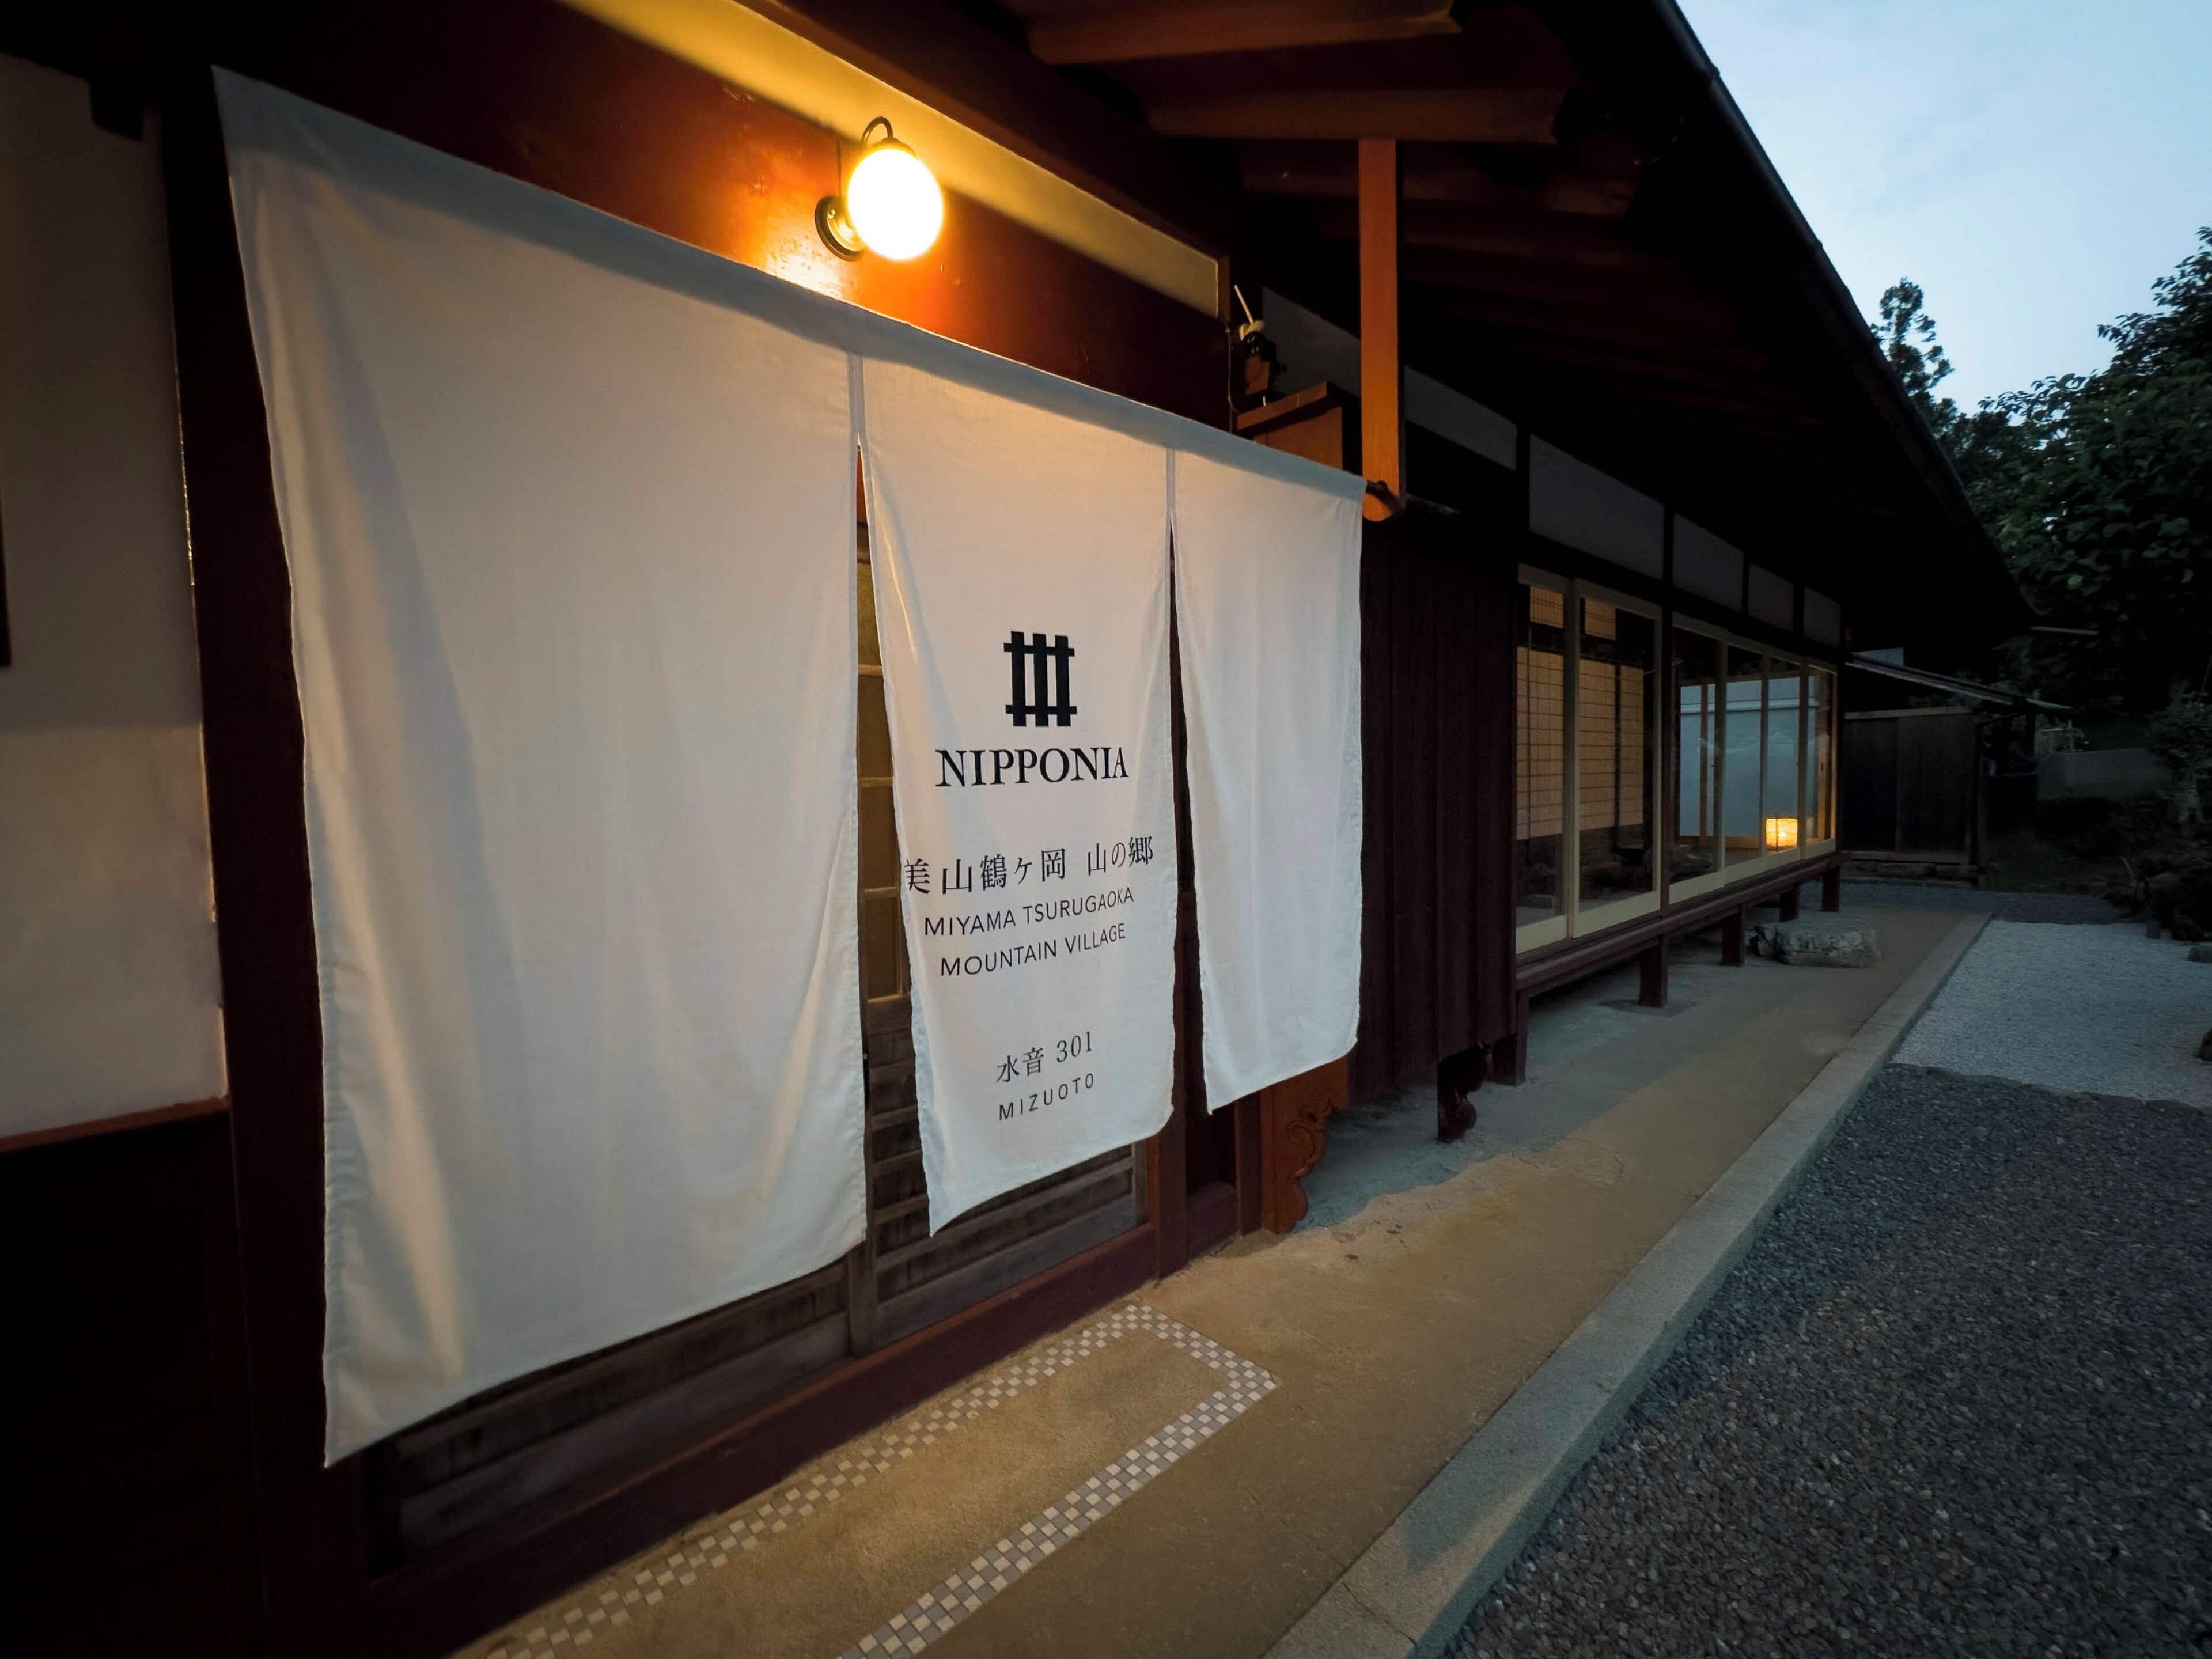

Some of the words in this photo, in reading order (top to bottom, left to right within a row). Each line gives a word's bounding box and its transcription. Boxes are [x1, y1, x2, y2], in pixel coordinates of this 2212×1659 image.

[935, 747, 1129, 787] NIPPONIA
[1087, 835, 1154, 876] 山の郷
[925, 909, 1016, 936] MIYAMA
[1022, 887, 1134, 924] TSURUGAOKA
[941, 939, 1057, 976] MOUNTAIN
[1064, 922, 1126, 955] VILLAGE
[996, 1047, 1044, 1083] 水音
[1056, 1031, 1092, 1063] 301
[999, 1073, 1094, 1120] MIZUOTO
